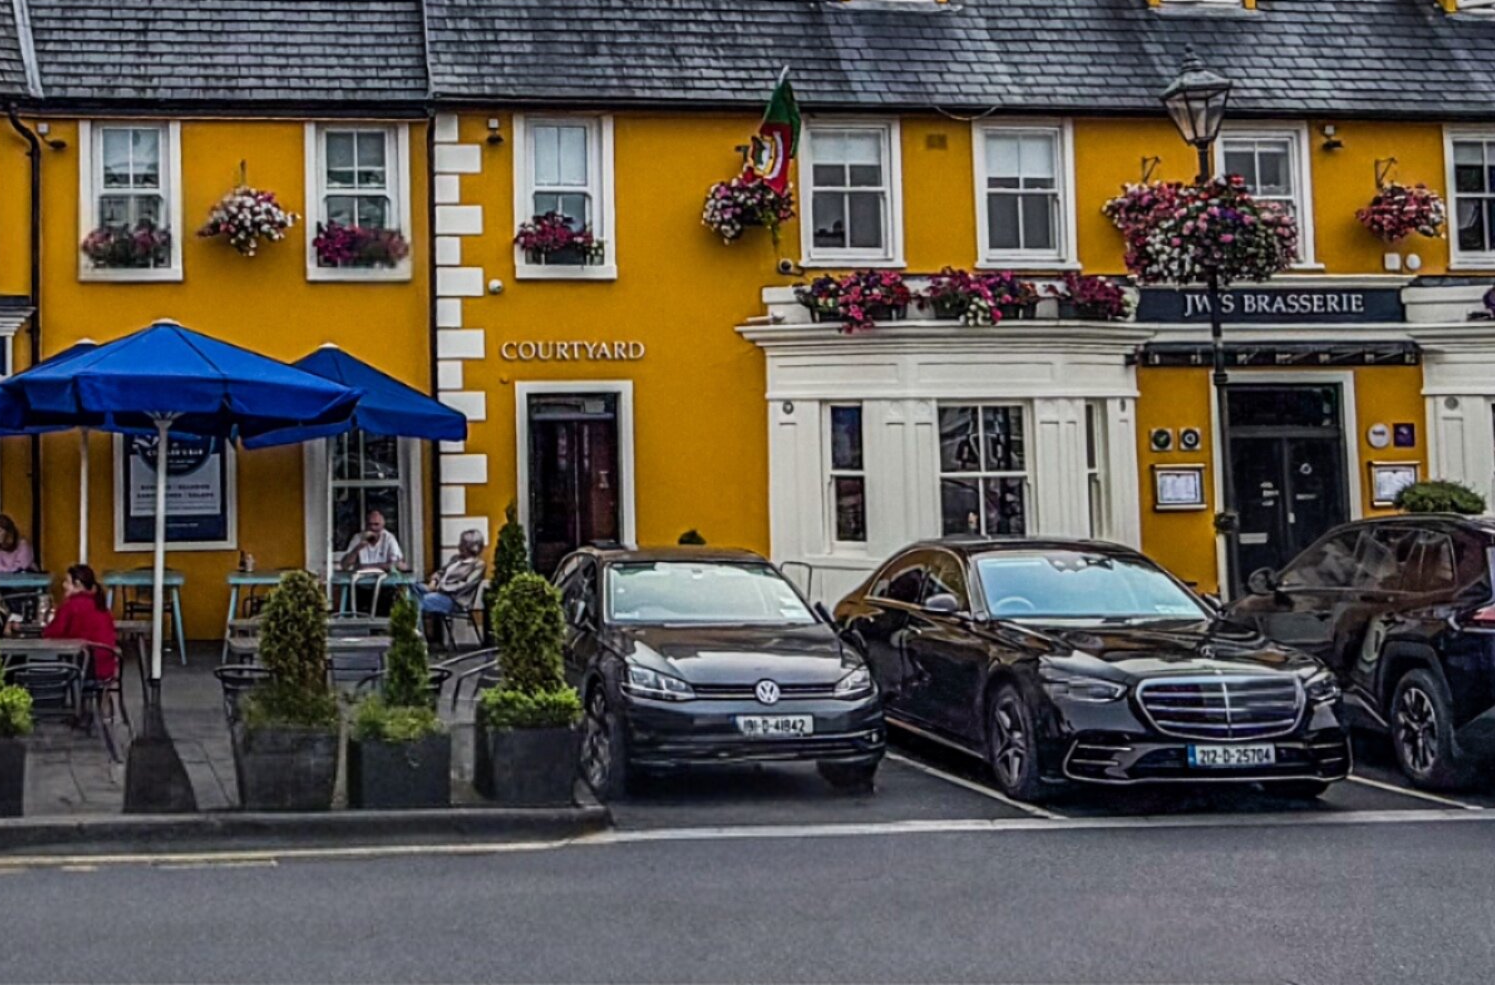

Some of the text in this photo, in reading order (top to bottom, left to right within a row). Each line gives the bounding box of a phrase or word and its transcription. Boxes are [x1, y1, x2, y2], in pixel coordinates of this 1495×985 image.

[1243, 293, 1365, 313] BRASSERIE
[500, 340, 646, 360] COURTYARD
[1199, 747, 1271, 764] 212-D-25704
